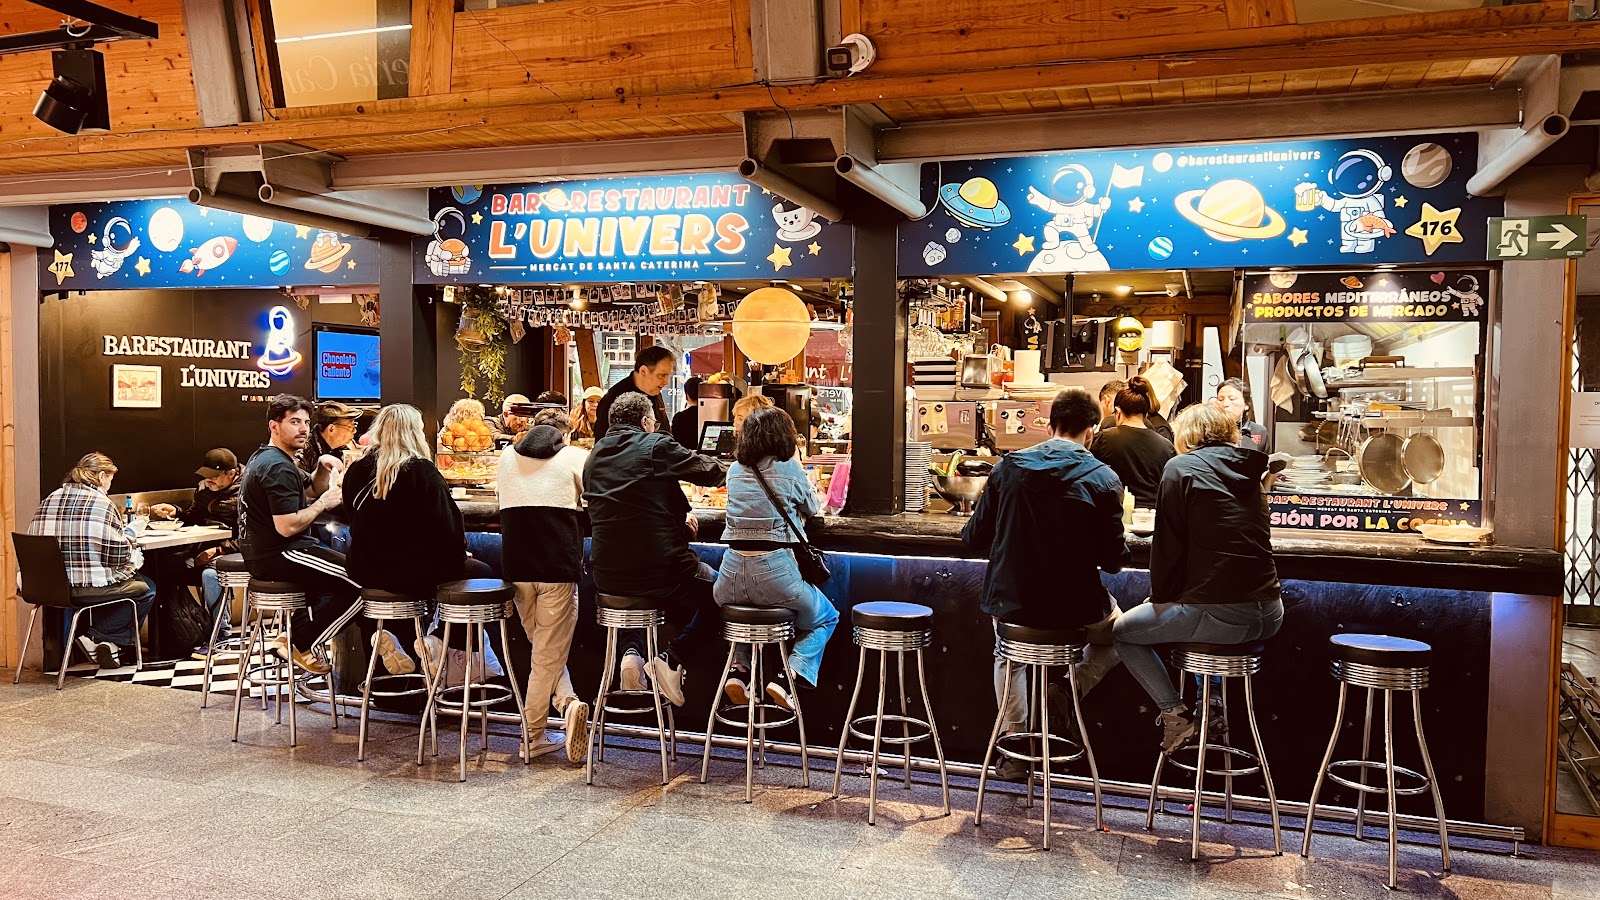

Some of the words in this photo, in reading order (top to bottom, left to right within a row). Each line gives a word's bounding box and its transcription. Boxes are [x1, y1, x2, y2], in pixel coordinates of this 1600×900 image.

[491, 193, 540, 215] BAR
[570, 184, 750, 214] RESTAURANT
[488, 212, 750, 259] L'UNIVERS
[1420, 220, 1452, 236] 176
[55, 261, 69, 272] 177
[529, 262, 575, 272] MERCAT
[579, 262, 593, 271] DE
[598, 261, 636, 271] SANTA
[640, 260, 699, 270] CATERINA
[1252, 292, 1320, 305] SABORES
[1325, 287, 1452, 304] MEDITERRÁNEOS
[1254, 305, 1345, 318] PRODUCTOS
[1349, 305, 1369, 317] DE
[1372, 304, 1448, 317] MERCADO
[103, 335, 252, 359] BARESTAURANT
[322, 352, 356, 366] Chocolate
[180, 364, 271, 389] L'UNIVERS
[322, 366, 351, 378] Caliente
[1267, 495, 1288, 505] BAR
[1300, 496, 1381, 509] RESTAURANT
[1382, 500, 1449, 511] L'UNIVERS
[1320, 514, 1359, 528] POR
[1365, 516, 1389, 530] LA
